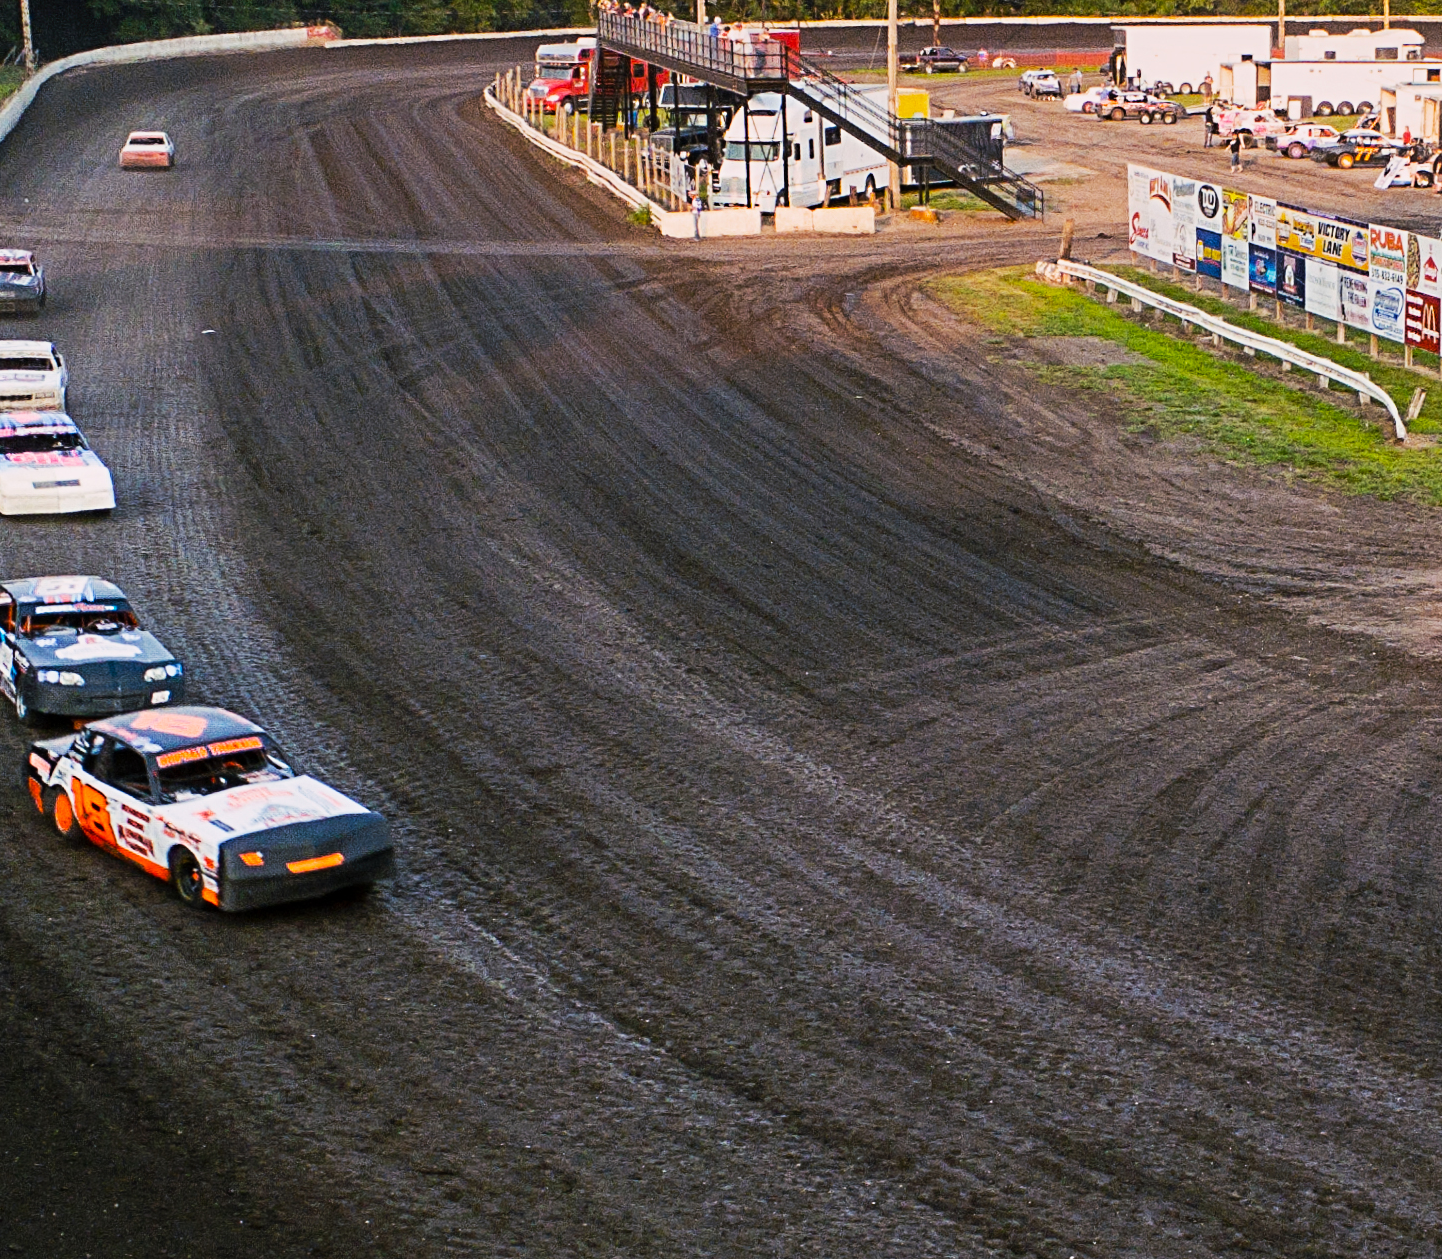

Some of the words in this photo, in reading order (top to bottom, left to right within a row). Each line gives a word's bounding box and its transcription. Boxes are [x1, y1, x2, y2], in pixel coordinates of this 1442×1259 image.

[1317, 221, 1351, 243] VICTORY
[1370, 228, 1405, 257] RUBA
[1322, 239, 1343, 257] LANE
[71, 775, 117, 848] 18
